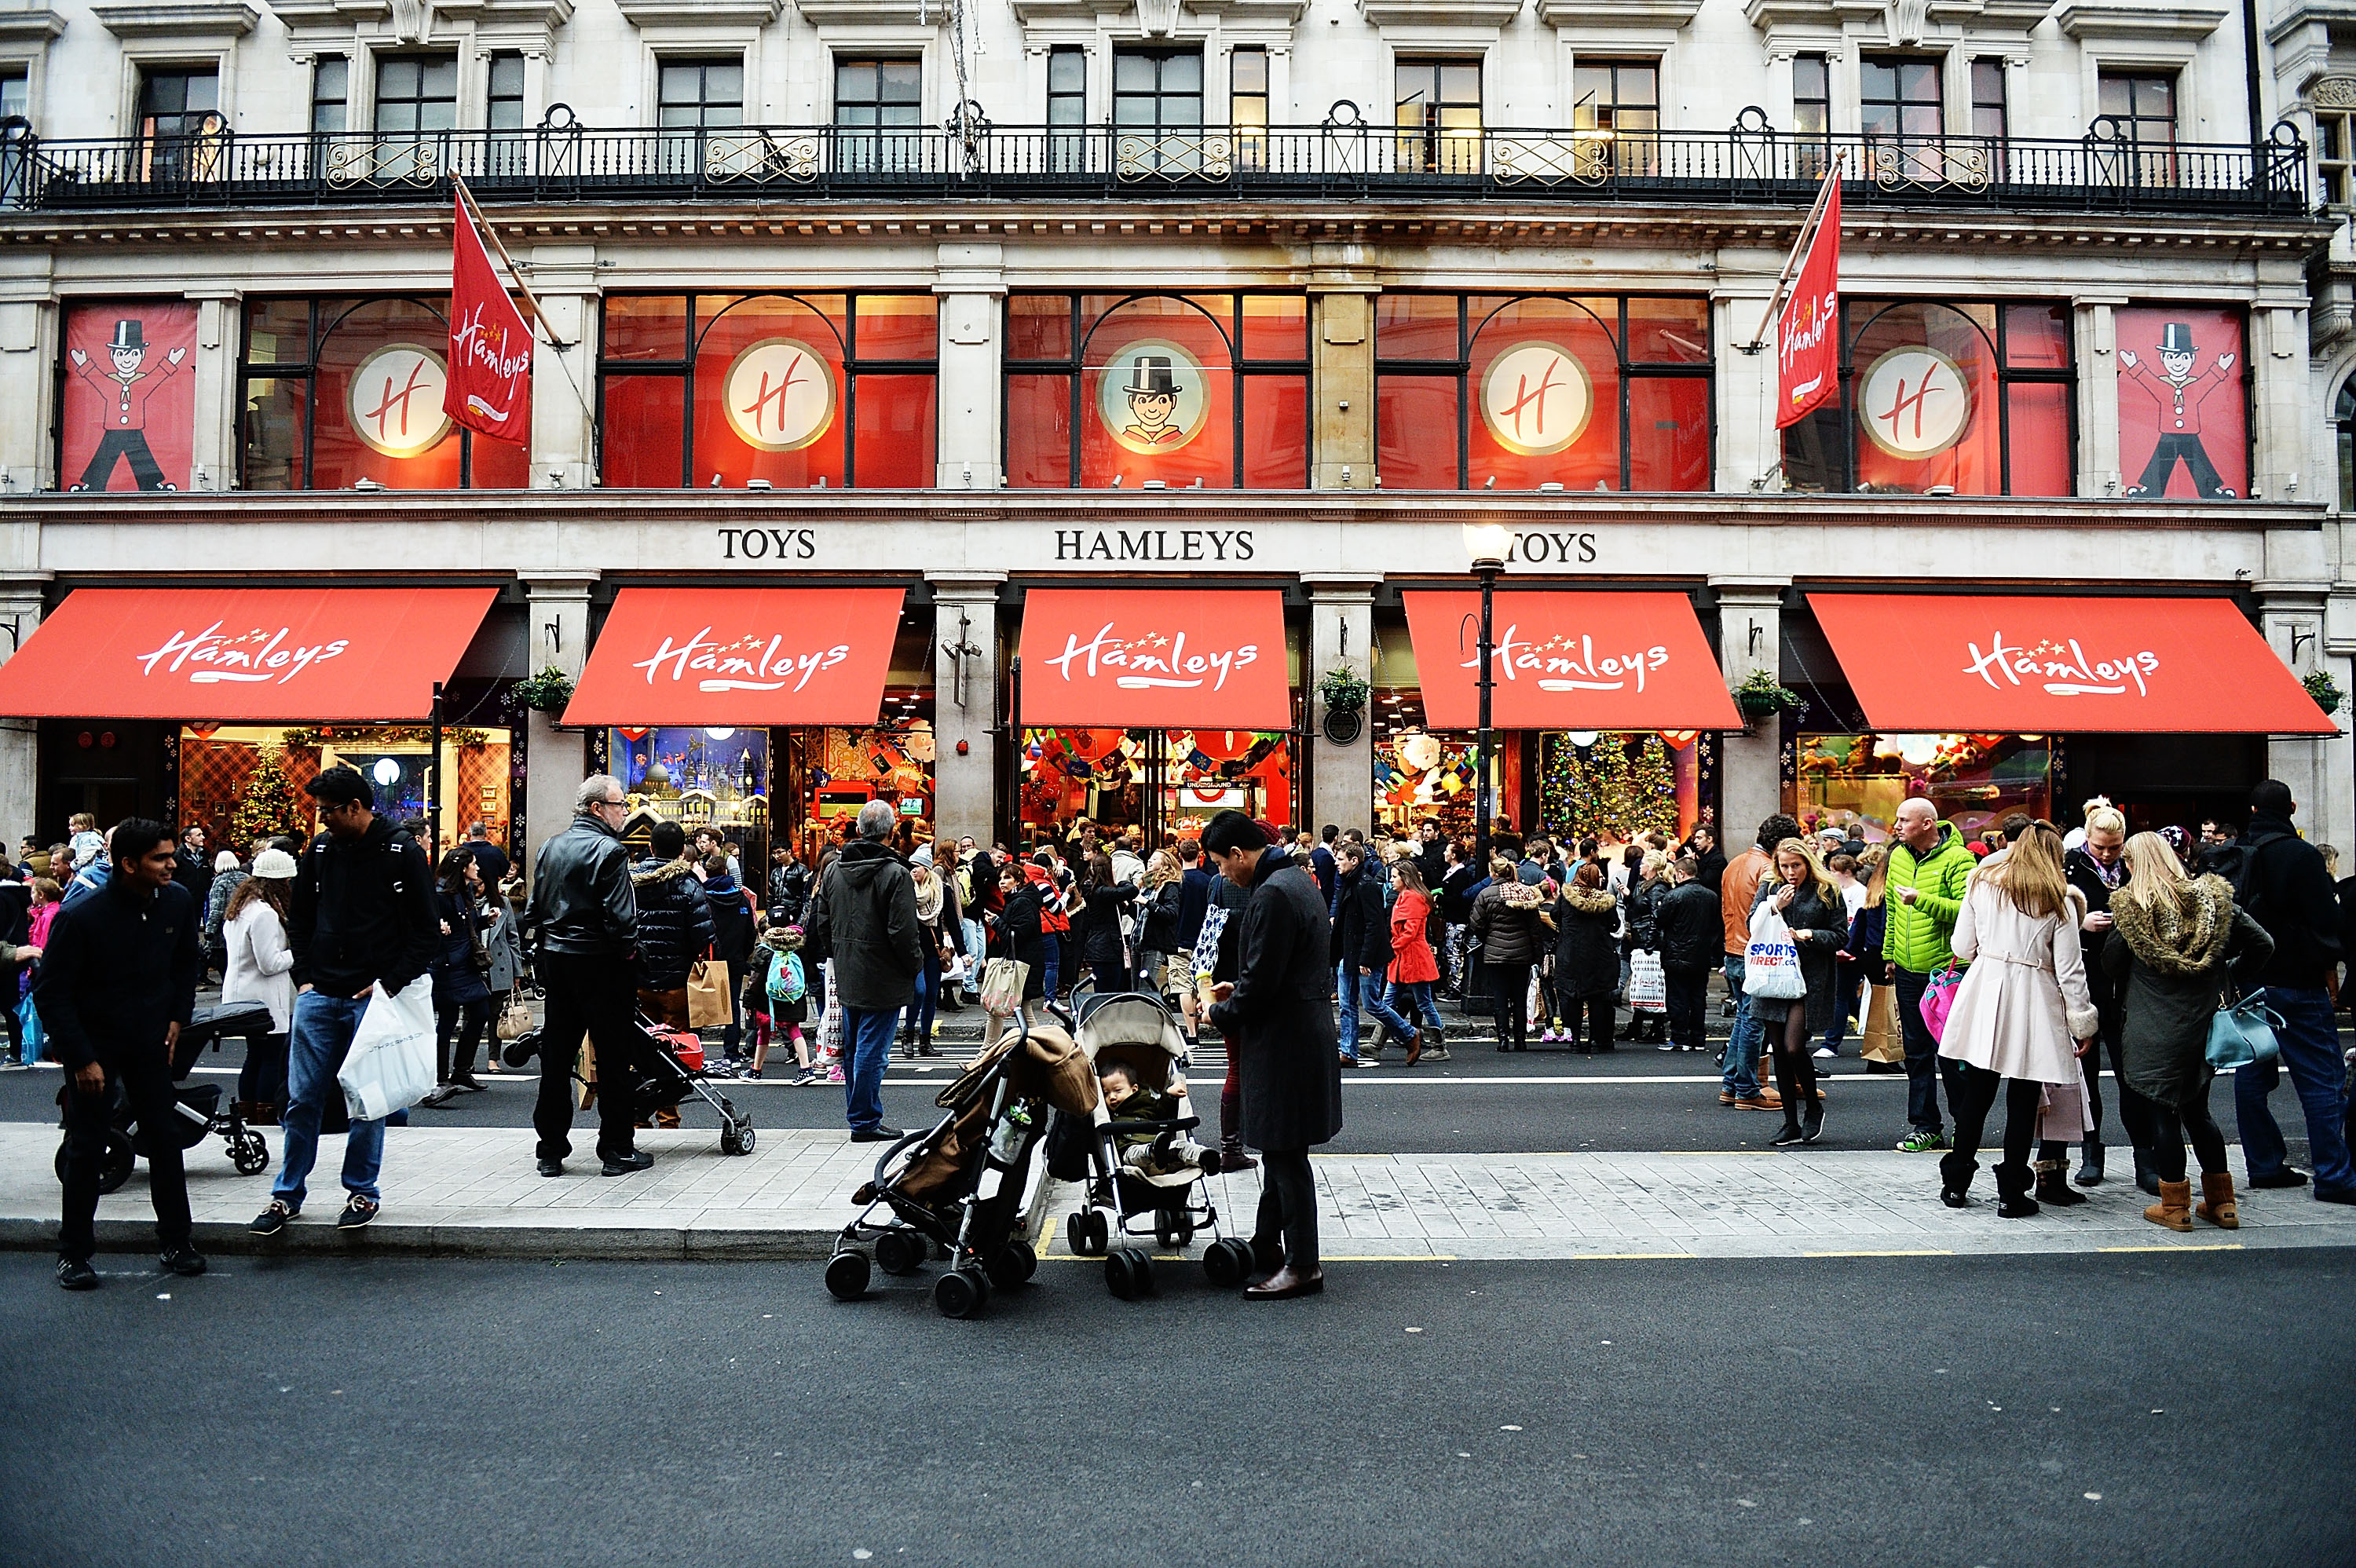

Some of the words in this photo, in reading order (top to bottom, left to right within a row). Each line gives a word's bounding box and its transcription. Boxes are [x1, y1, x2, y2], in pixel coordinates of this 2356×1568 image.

[452, 302, 529, 401] Hamleys
[365, 358, 431, 440] H
[742, 353, 809, 437] H
[1499, 356, 1568, 440] H
[1878, 361, 1945, 444] H
[718, 529, 815, 559] TOYS
[1054, 530, 1254, 561] HAMLEYS
[137, 620, 349, 685] Hamleys
[633, 626, 850, 693] Hamleys
[1044, 621, 1258, 692] Hamleys
[1459, 623, 1670, 693] Hamleys
[1962, 630, 2160, 697] Hamleys
[1750, 943, 1797, 959] SPORTS
